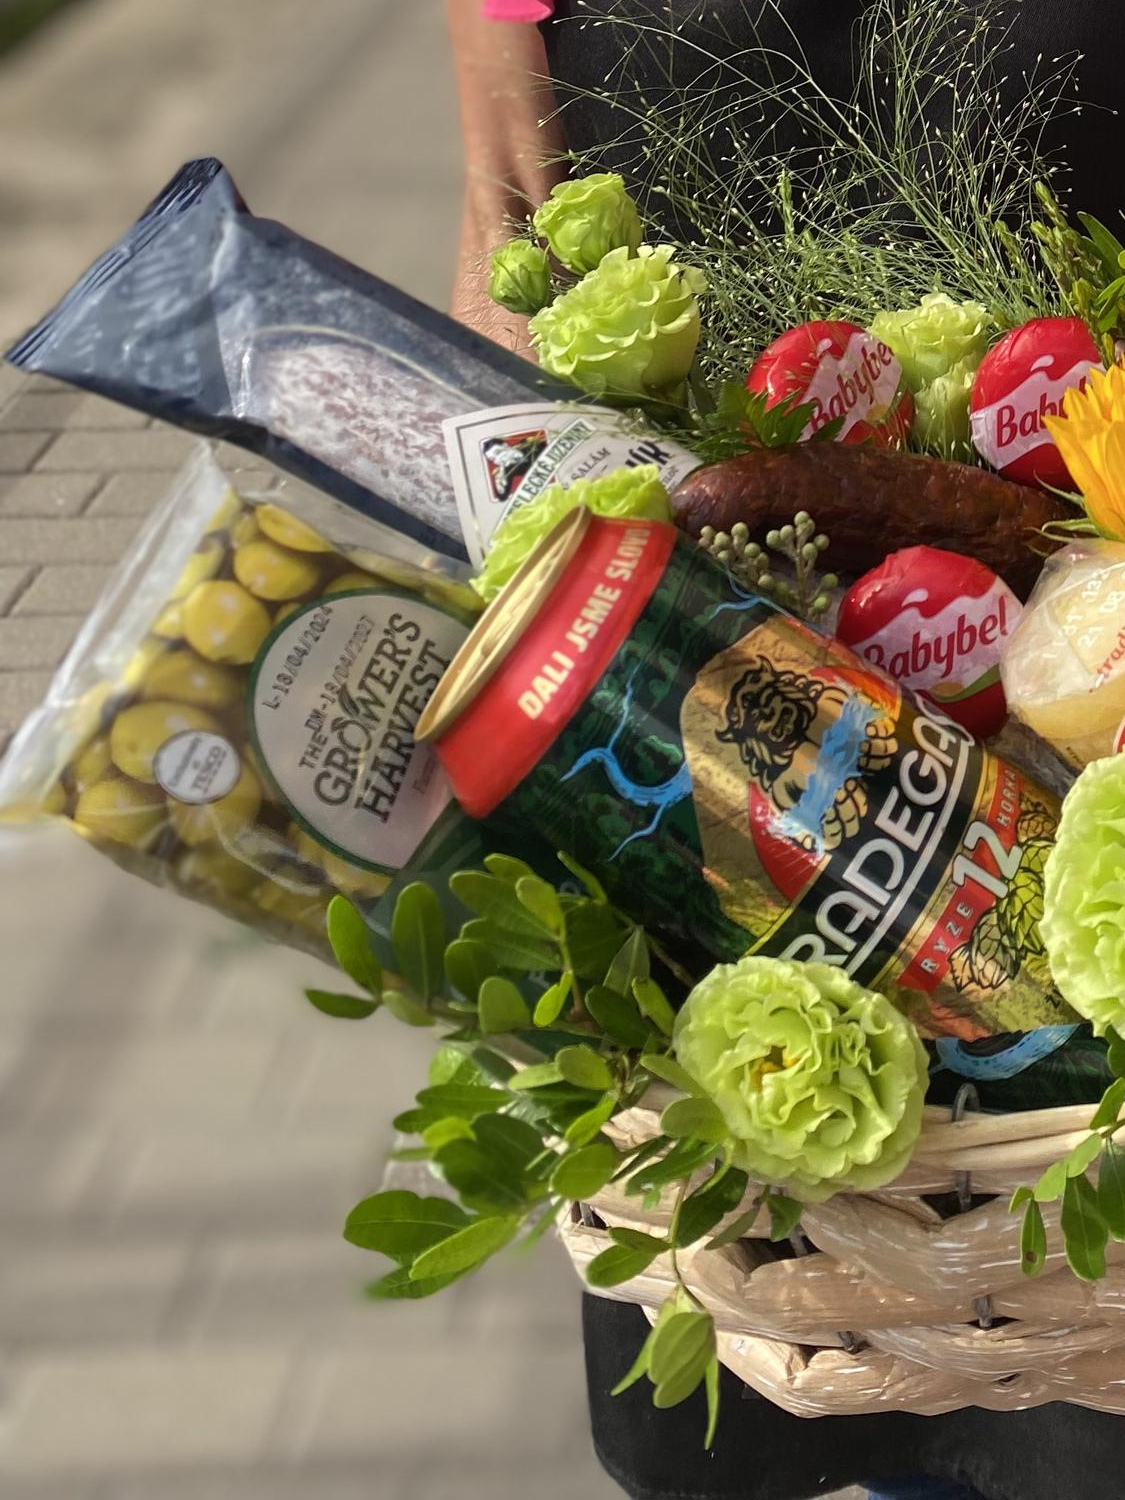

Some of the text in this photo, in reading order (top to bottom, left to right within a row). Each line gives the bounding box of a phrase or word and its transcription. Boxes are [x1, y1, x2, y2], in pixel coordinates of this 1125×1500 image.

[570, 447, 611, 481] SALÁM
[517, 651, 575, 720] DALI
[565, 583, 623, 654] JSME
[863, 596, 1010, 679] Babybel
[299, 729, 329, 769] THE
[313, 612, 422, 807] GROWER'S
[354, 639, 450, 824] HARVEST
[919, 902, 973, 974] RYZE
[953, 820, 1023, 899] 12
